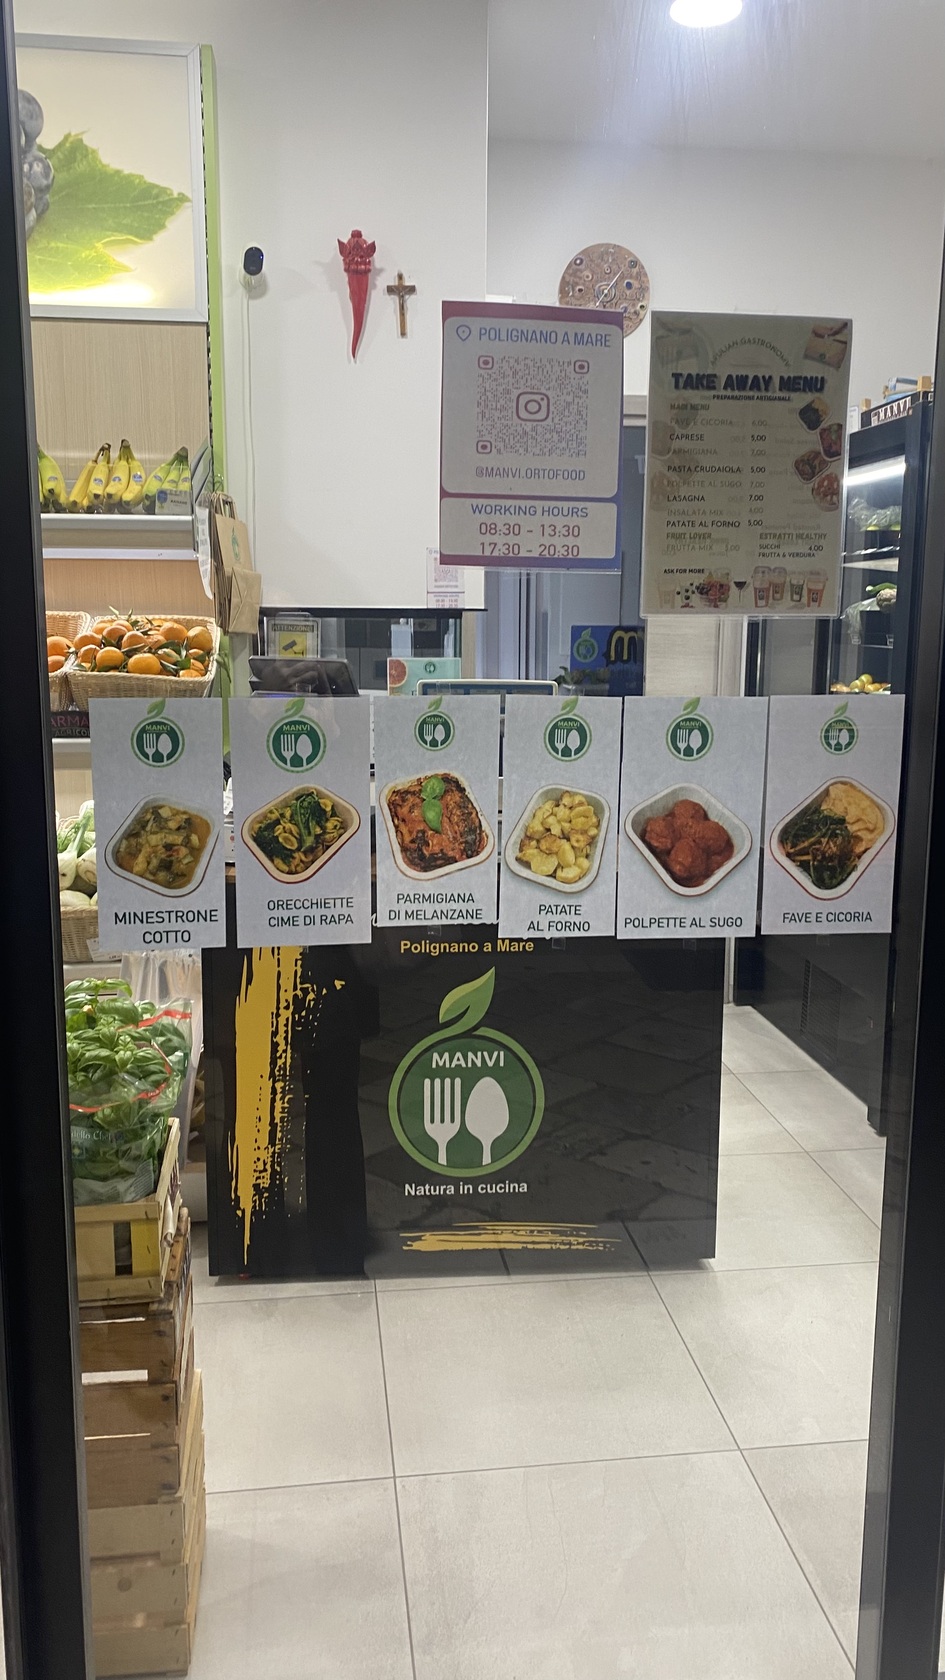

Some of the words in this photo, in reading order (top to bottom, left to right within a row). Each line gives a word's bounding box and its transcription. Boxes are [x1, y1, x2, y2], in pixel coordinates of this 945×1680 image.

[478, 327, 558, 345] POLIGNANO
[562, 330, 571, 345] A
[574, 332, 612, 347] MARE
[672, 372, 718, 390] TAKE
[722, 374, 772, 392] AWAY
[778, 375, 826, 393] MENU
[700, 418, 734, 426] CICORIA
[669, 434, 704, 442] CAPRESE
[750, 434, 766, 442] 5,00
[476, 466, 586, 482] @MANVI.ORTOFOOD
[667, 465, 692, 473] PASTA
[694, 466, 742, 474] CRUDAIOLA
[750, 466, 766, 474] 5,00
[666, 480, 705, 488] POLPETTE
[708, 480, 718, 488] AL
[667, 494, 706, 502] LASAGNA
[748, 494, 764, 502] 7,00
[470, 504, 538, 517] WORKING
[541, 506, 588, 518] HOURS
[478, 522, 521, 536] 08:30
[540, 524, 580, 538] 13:30
[666, 520, 696, 528] PATATE
[698, 520, 708, 528] AL
[711, 520, 741, 528] FORNO
[666, 532, 686, 540] FRUIT
[688, 532, 712, 540] LOVER
[759, 532, 794, 540] ESTRATTI
[795, 532, 828, 541] HEALTHY
[478, 543, 520, 556] 17:30
[538, 544, 580, 558] 20:30
[666, 544, 696, 552] FRUTTA
[698, 544, 714, 552] MIX
[282, 724, 310, 732] MANVI
[267, 897, 354, 911] ORECCHIETTE
[396, 892, 475, 904] PARMIGIANA
[388, 910, 400, 920] DI
[404, 908, 483, 920] MELANZANE
[538, 904, 582, 916] PATATE
[114, 909, 219, 926] MINESTRONE
[268, 916, 300, 928] CIME
[302, 915, 316, 927] DI
[319, 914, 354, 925] RAPA
[624, 917, 686, 928] POLPETTE
[690, 917, 705, 928] AL
[709, 916, 743, 928] SUGO
[782, 912, 812, 923] FAVE
[815, 912, 822, 922] E
[826, 911, 872, 923] CICORIA
[527, 921, 544, 932] AL
[548, 920, 590, 932] FORNO
[142, 930, 192, 944] COTTO
[401, 939, 478, 956] Polignano
[483, 942, 492, 952] a
[497, 940, 534, 952] Mare
[432, 1050, 505, 1068] MANVI
[404, 1182, 455, 1196] Natura
[460, 1182, 472, 1194] in
[480, 1181, 528, 1194] cucina
